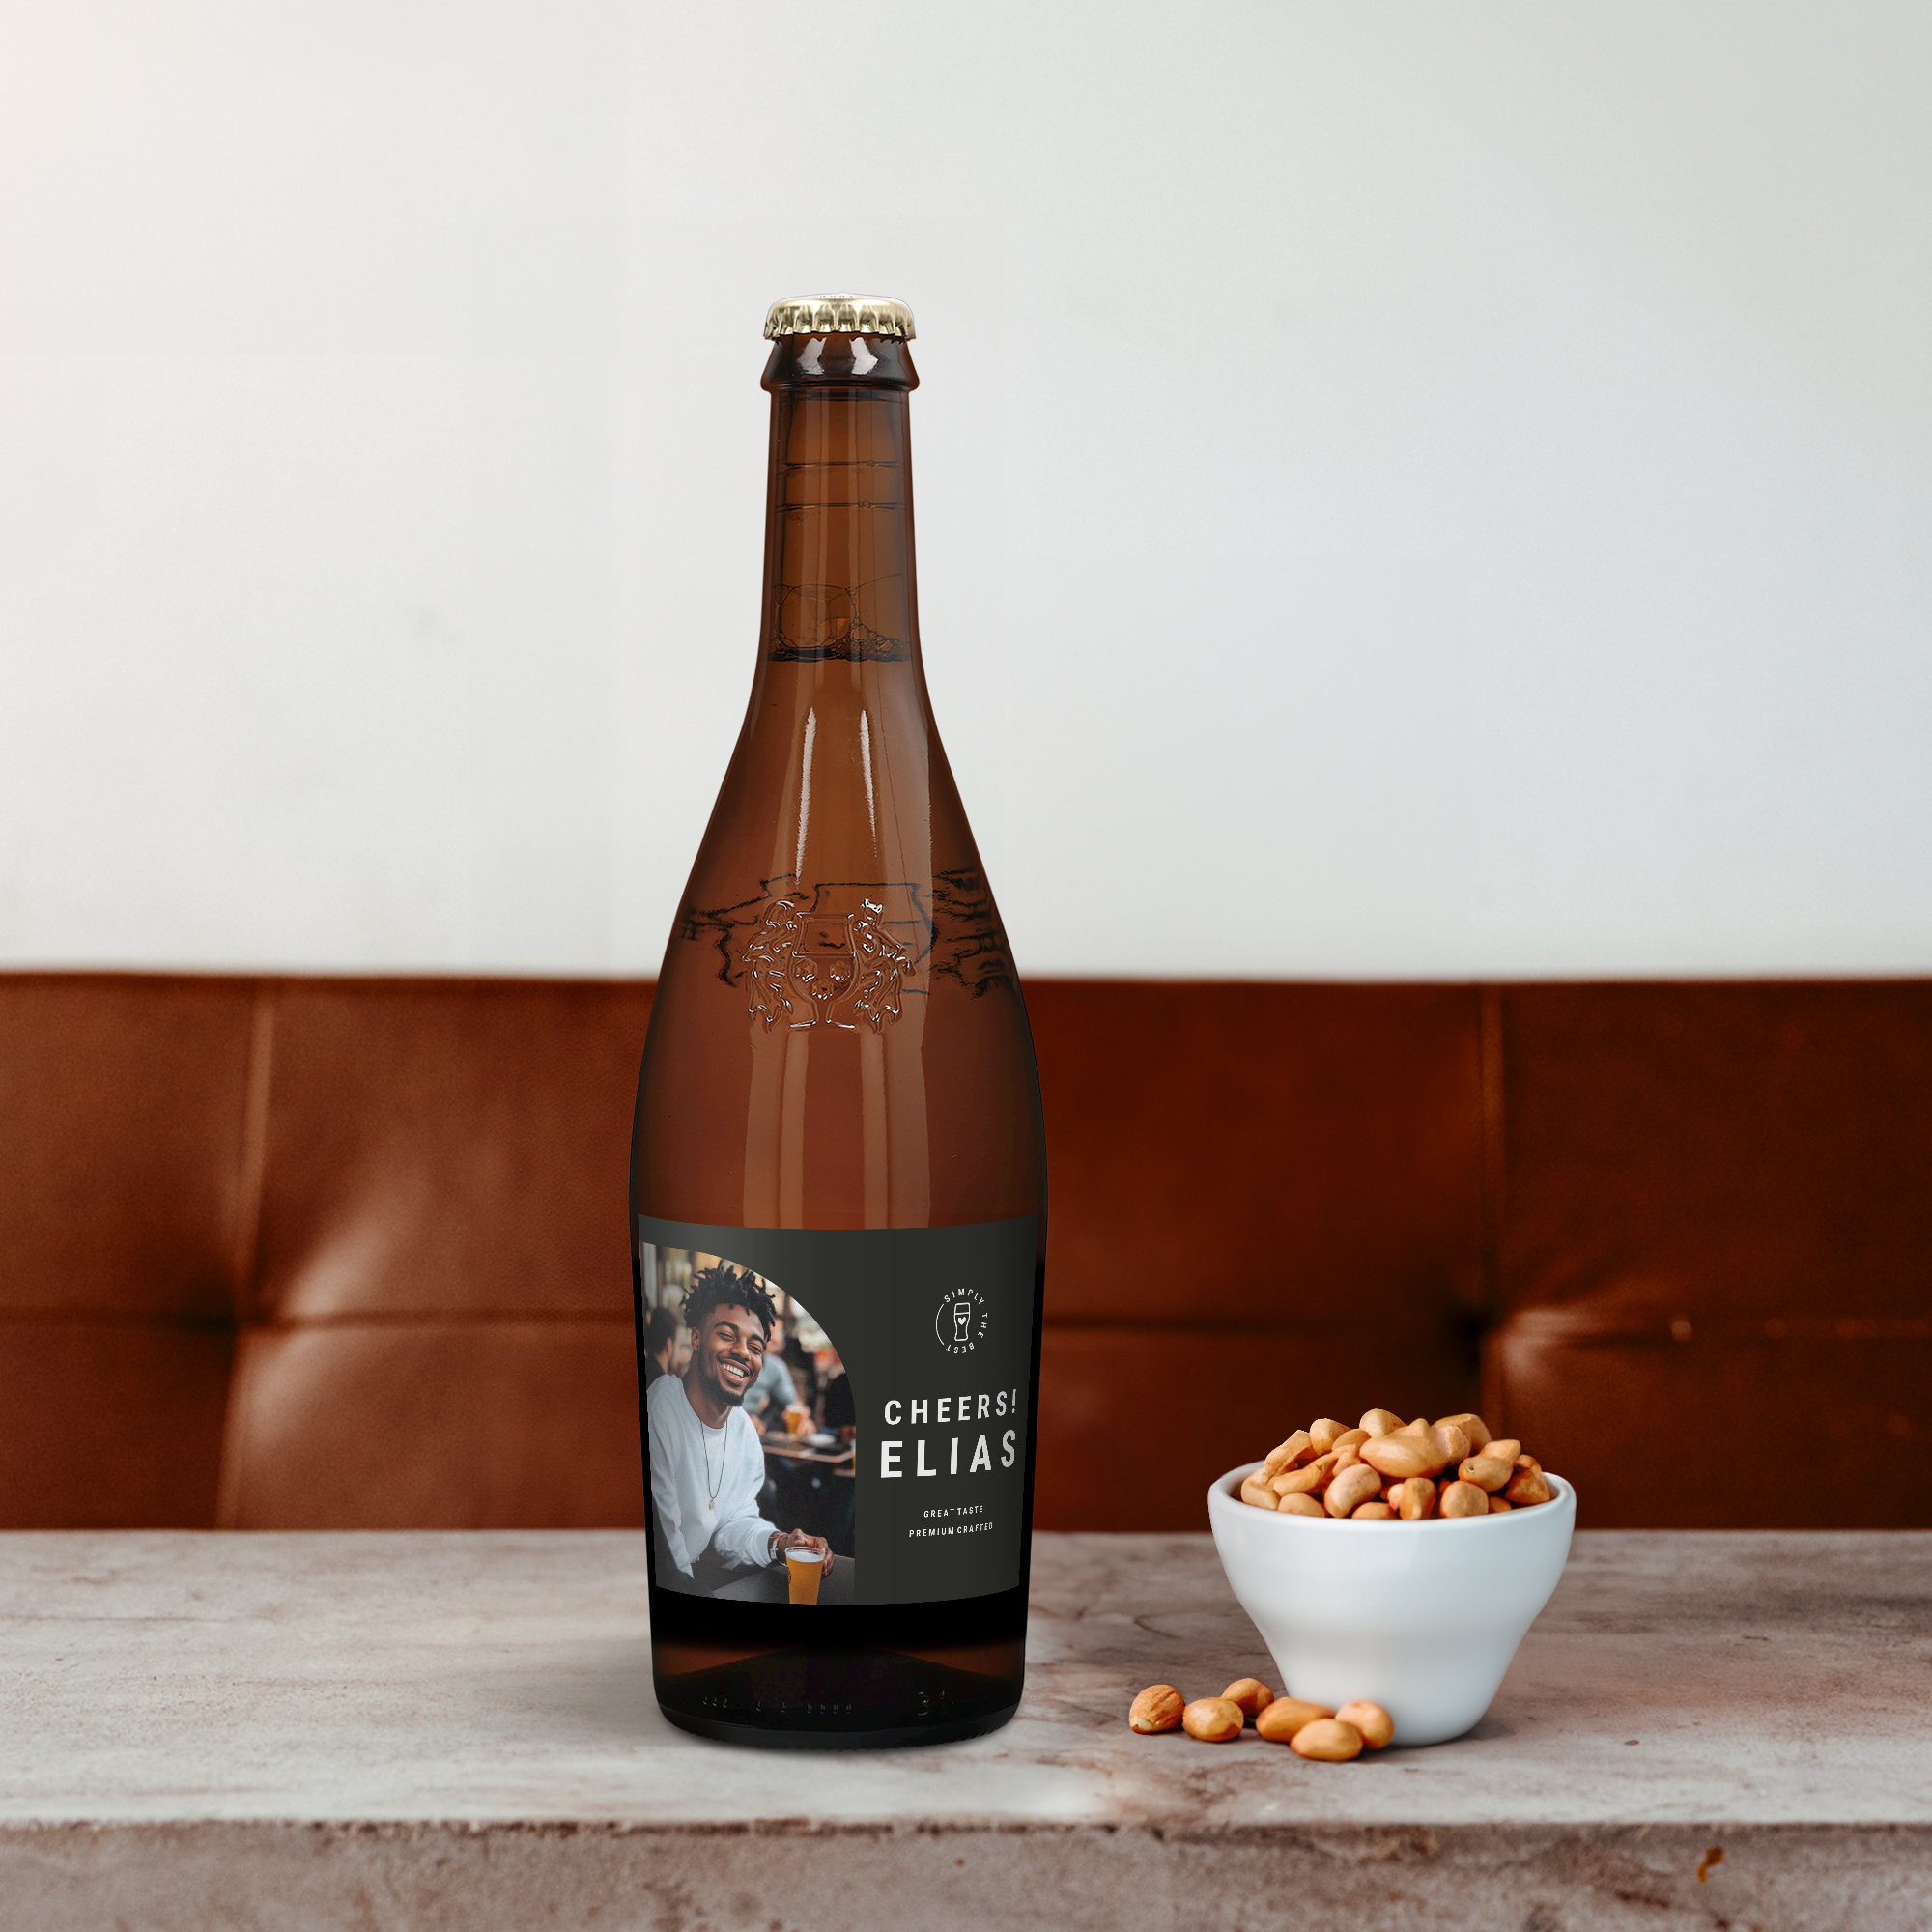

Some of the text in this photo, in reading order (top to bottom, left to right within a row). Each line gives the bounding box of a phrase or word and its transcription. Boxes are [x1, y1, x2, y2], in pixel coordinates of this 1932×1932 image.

[944, 1288, 988, 1354] SIMPLY THE BEST
[885, 1389, 1017, 1426] CHEERS!
[881, 1430, 1016, 1479] ELIAS
[909, 1522, 993, 1538] PREMIUM CRAFTED
[923, 1505, 983, 1519] GREAT TASTE
